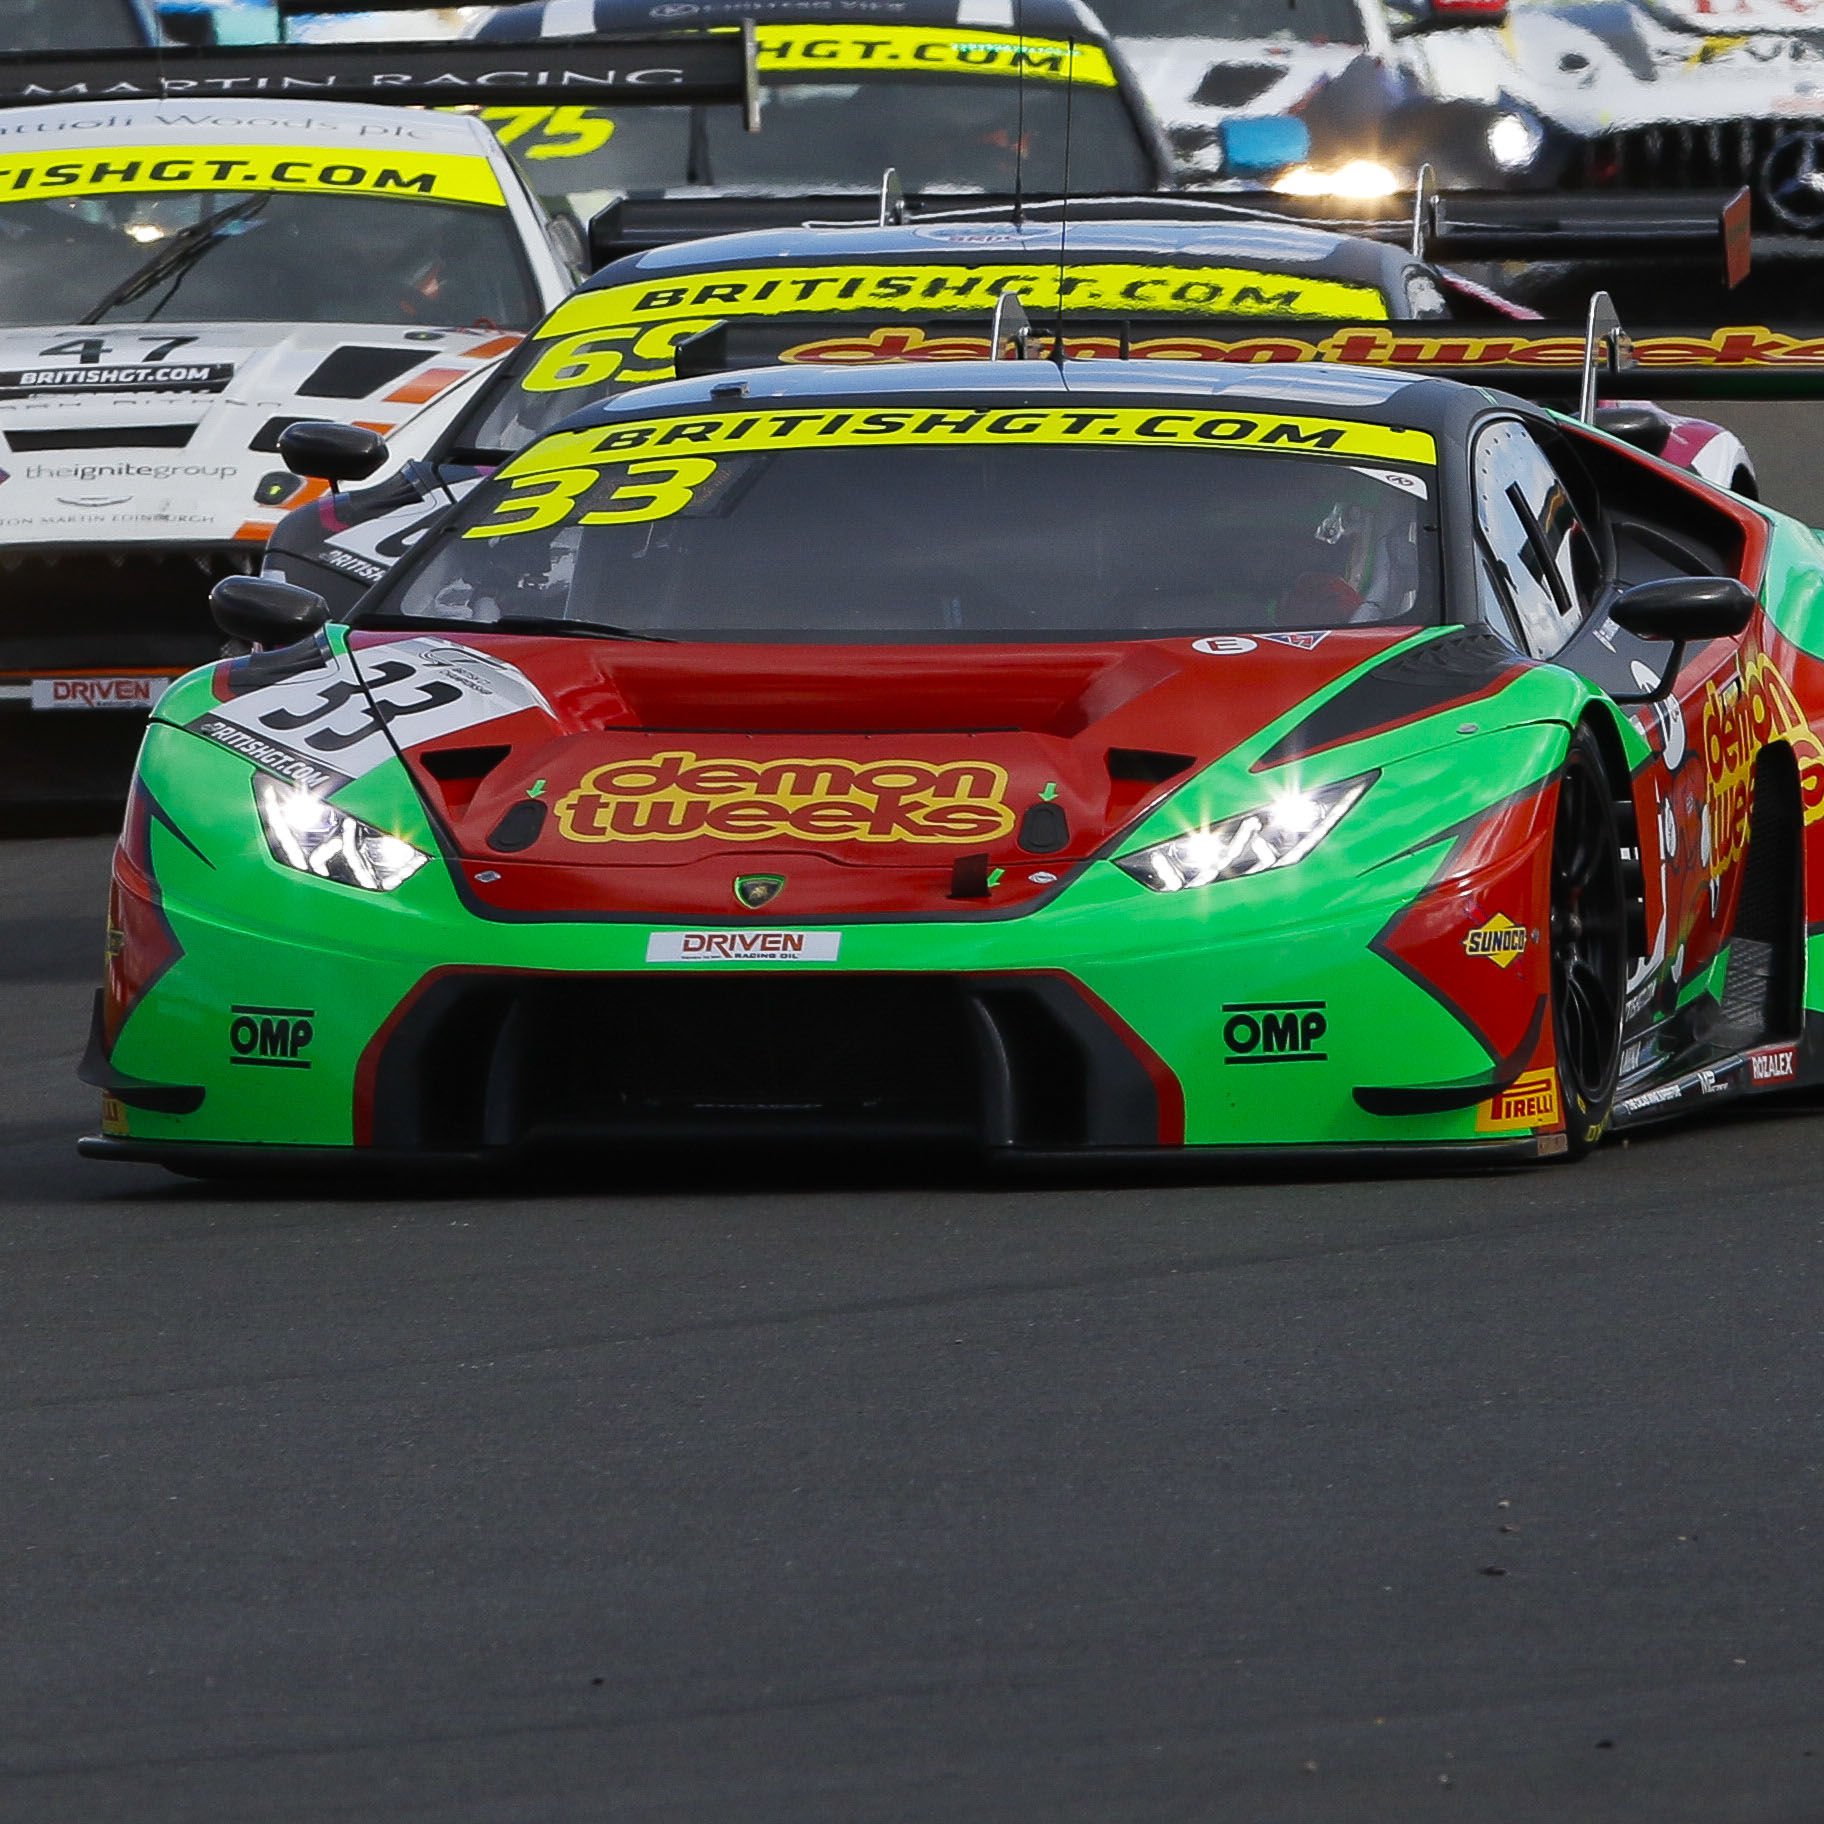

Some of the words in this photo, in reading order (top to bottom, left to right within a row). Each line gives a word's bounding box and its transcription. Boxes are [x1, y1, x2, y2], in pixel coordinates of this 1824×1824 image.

[22, 75, 335, 96] MARTIN
[375, 68, 684, 87] RACING
[153, 113, 340, 132] Woods
[359, 122, 434, 141] plc
[477, 106, 616, 160] 75
[633, 273, 1301, 312] BRITISHGT.COM
[39, 336, 200, 364] 47
[778, 327, 1318, 363] demon
[20, 366, 211, 386] BRITISHGT.COM
[591, 409, 1346, 454] BRITISHGT.COM
[462, 457, 717, 539] 33
[52, 679, 150, 708] DRIVEN
[259, 661, 463, 752] 33
[209, 719, 333, 788] BRITISHGT.COM
[581, 752, 1009, 800] demon
[558, 790, 1013, 841] tweeks
[683, 933, 804, 957] DRIVEN
[1467, 929, 1525, 953] SUNOCO
[230, 1017, 314, 1059] OMP
[1223, 1011, 1328, 1054] OMP
[1752, 1052, 1794, 1080] ROZALEX
[1491, 1078, 1553, 1120] PIRELLI
